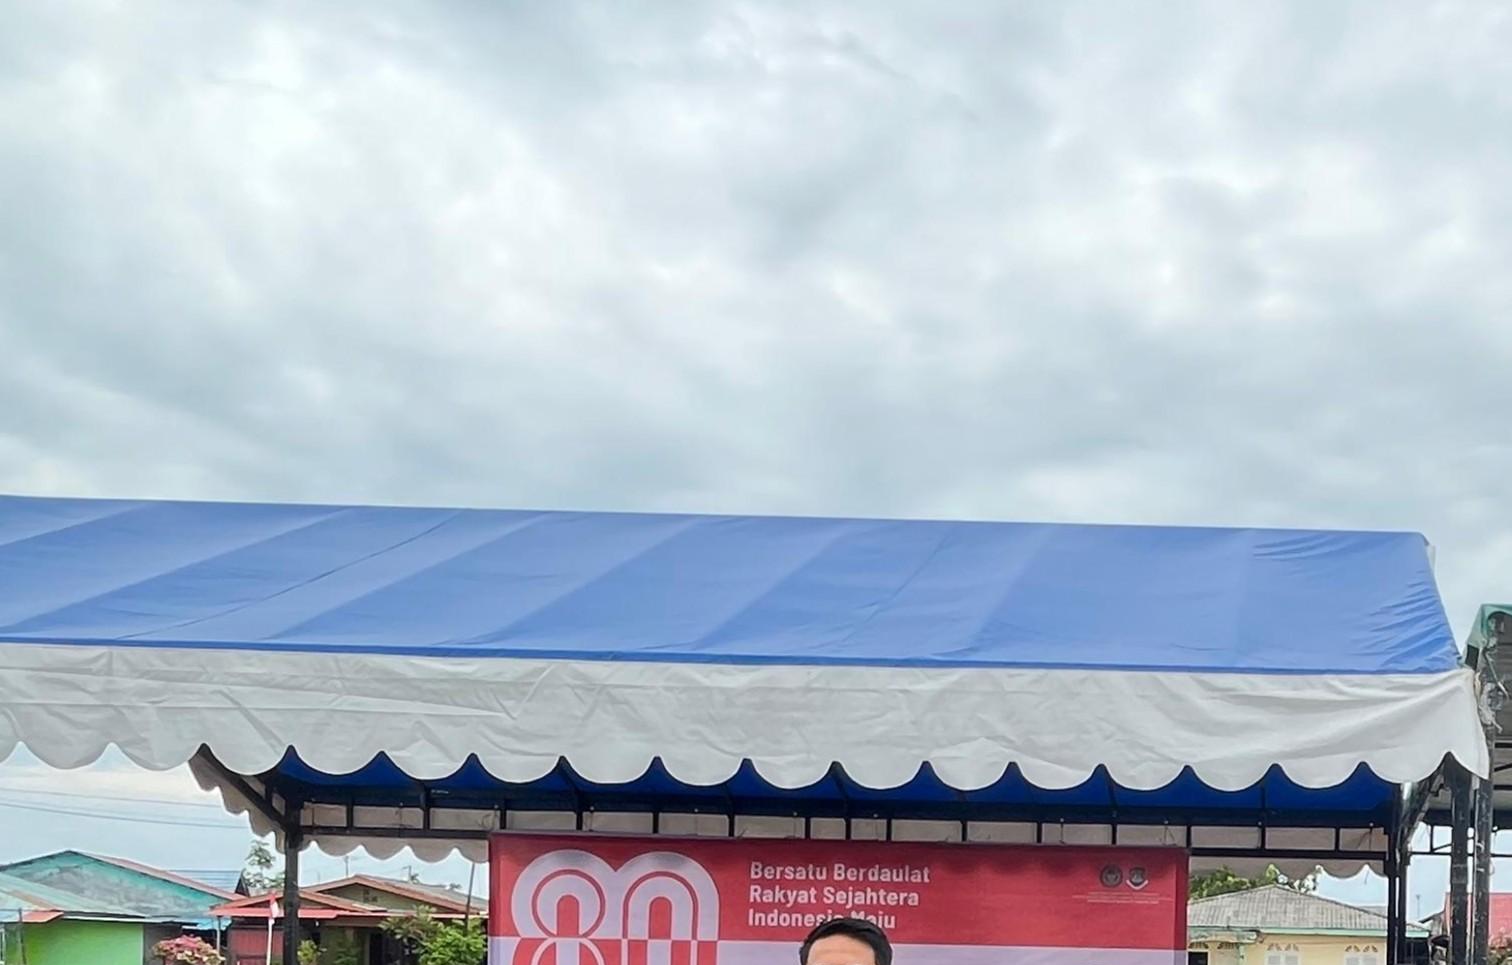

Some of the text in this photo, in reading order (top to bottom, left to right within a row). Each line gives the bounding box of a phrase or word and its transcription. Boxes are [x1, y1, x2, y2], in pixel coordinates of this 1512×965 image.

[750, 861, 931, 883] Bersatu Berdaulat
[750, 885, 920, 909] Rakyat Sejahtera
